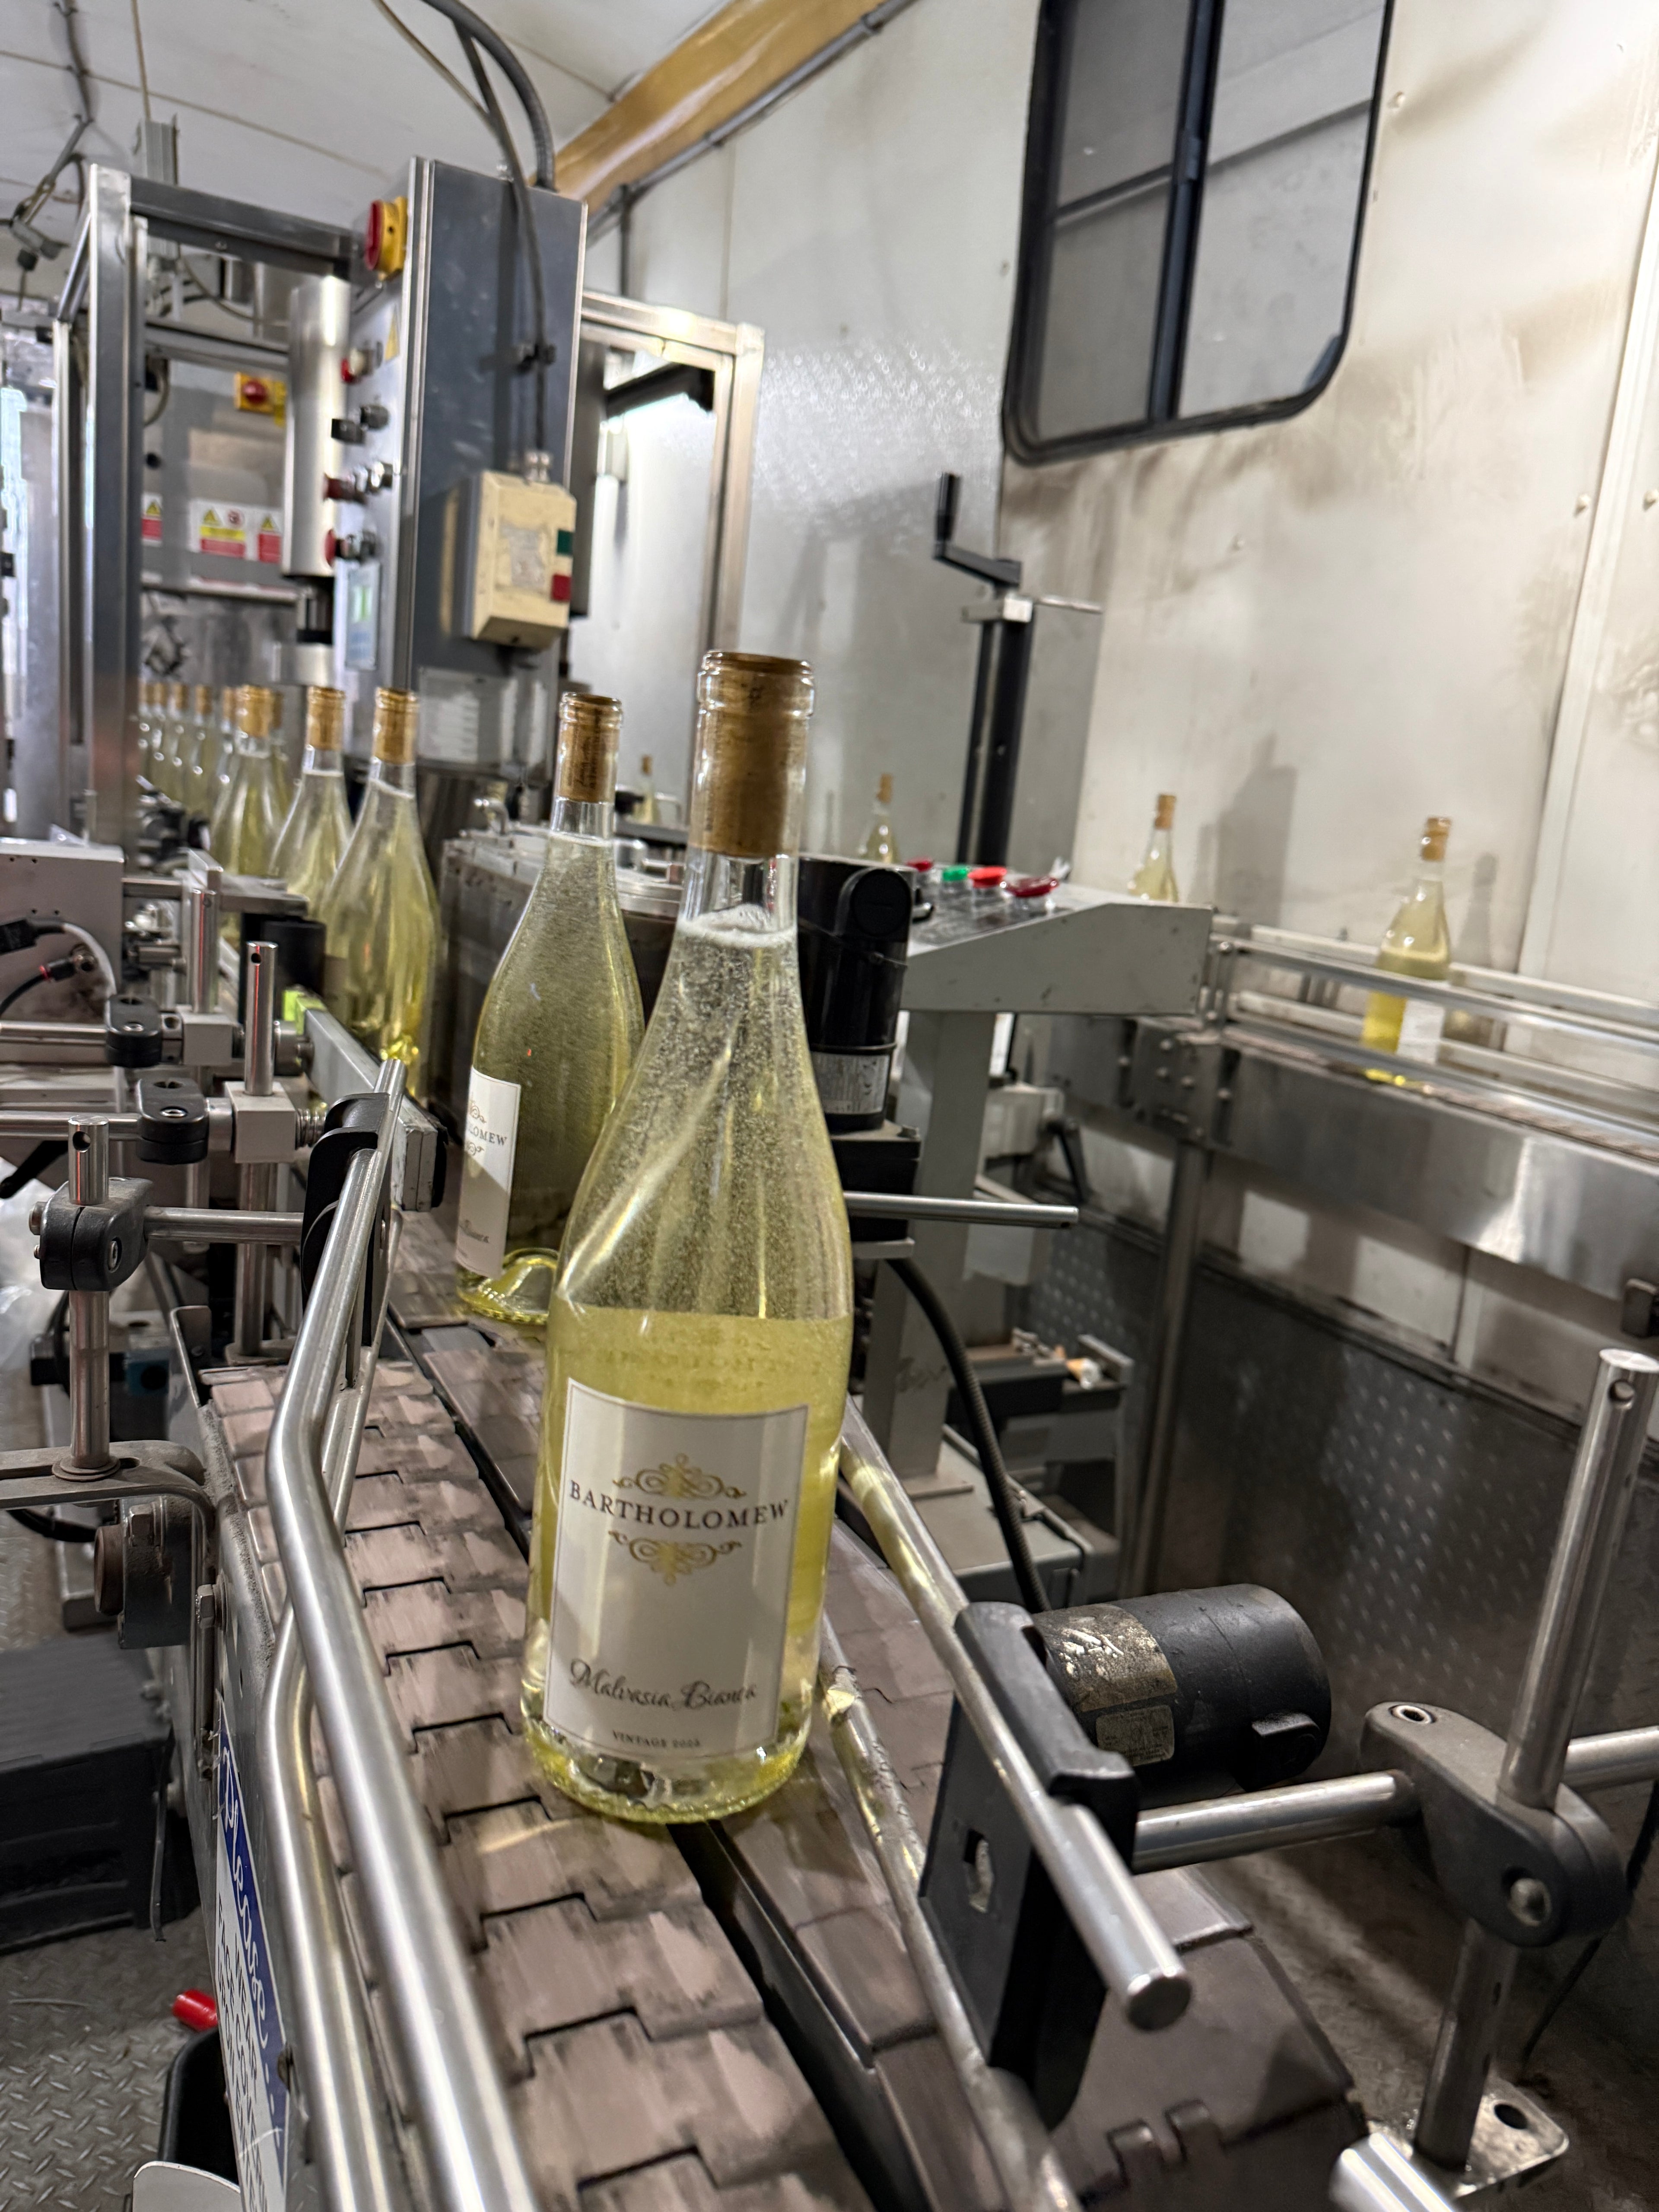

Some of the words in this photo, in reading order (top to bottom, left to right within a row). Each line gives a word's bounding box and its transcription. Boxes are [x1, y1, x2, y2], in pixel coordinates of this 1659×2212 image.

[569, 1480, 788, 1529] BARTHOLOMEW
[612, 1729, 667, 1748] VINTAGE
[218, 1945, 235, 2086] UPON
[219, 1891, 235, 2024] FACE
[235, 1932, 257, 2103] WEAR
